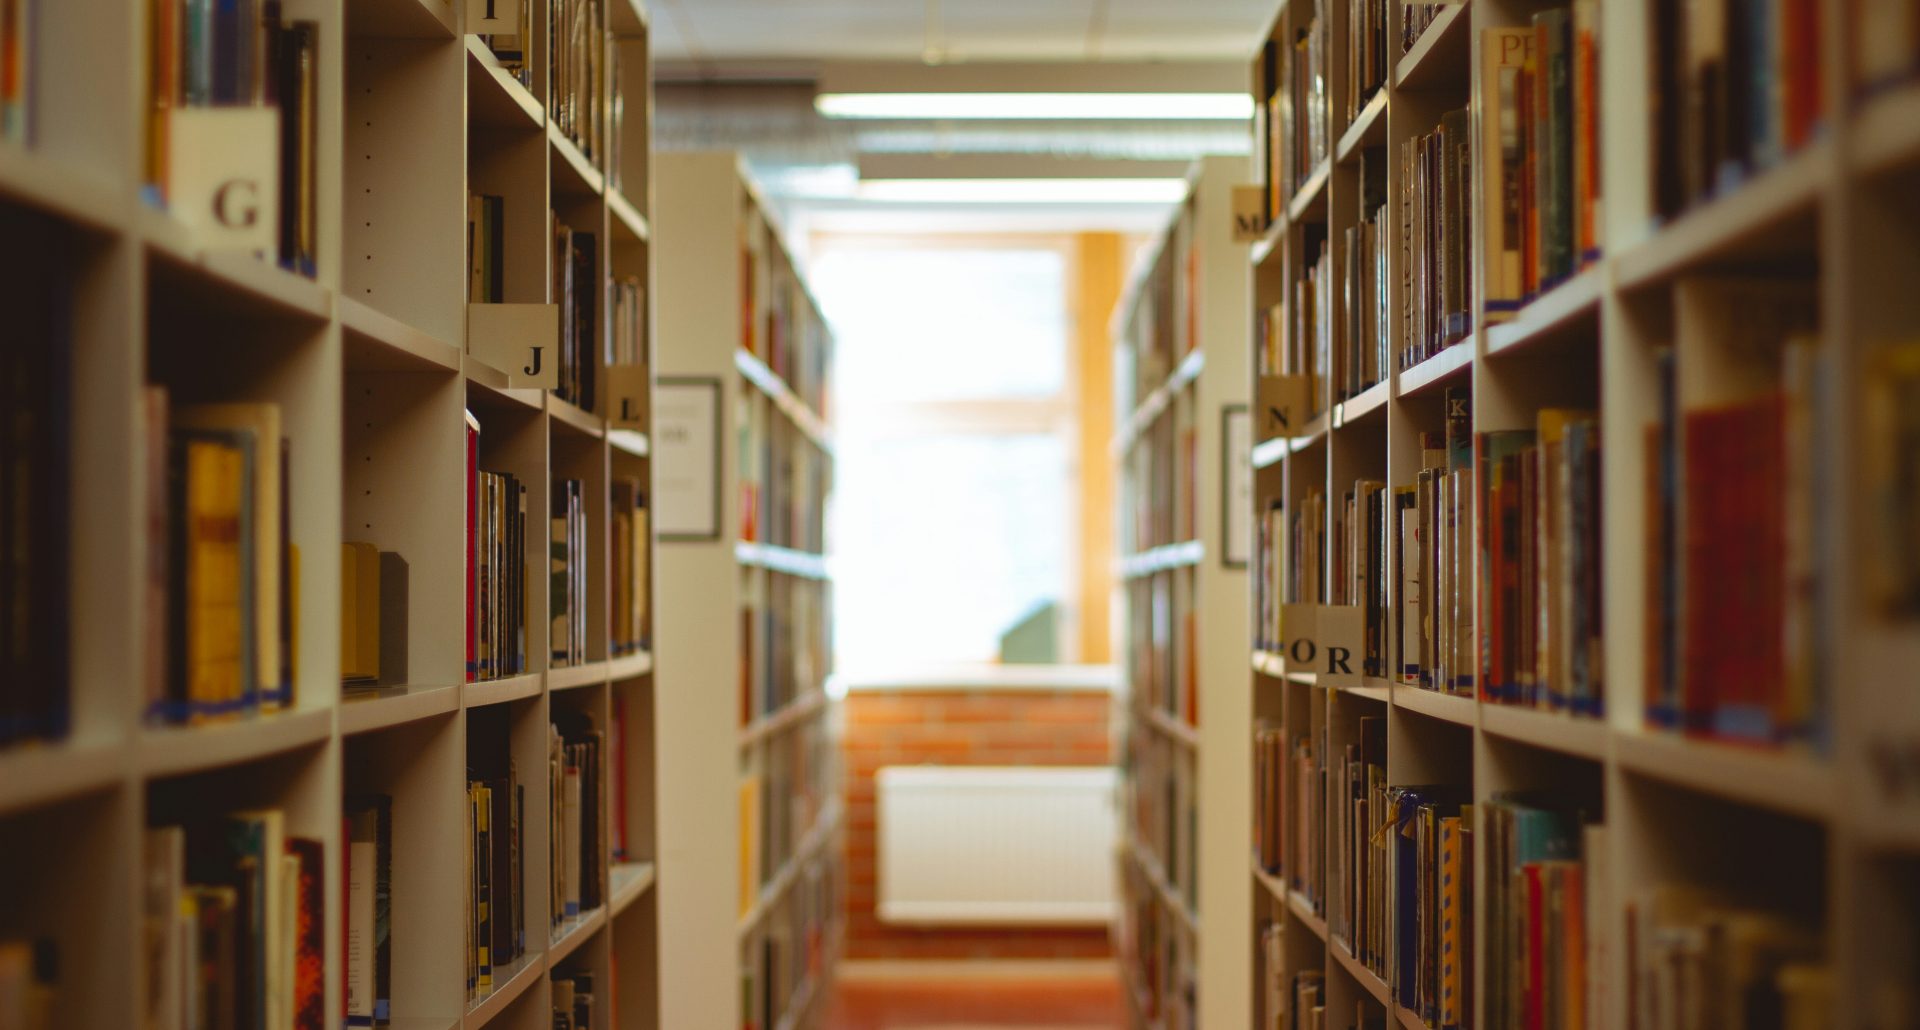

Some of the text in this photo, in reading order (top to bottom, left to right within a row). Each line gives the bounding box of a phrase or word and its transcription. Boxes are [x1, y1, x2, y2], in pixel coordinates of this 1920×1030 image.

[210, 178, 259, 230] G
[1235, 213, 1261, 235] M
[523, 346, 545, 376] J
[618, 397, 641, 422] L
[1267, 405, 1291, 431] N
[1450, 399, 1467, 417] K
[1291, 638, 1317, 664] O
[1325, 646, 1354, 675] R
